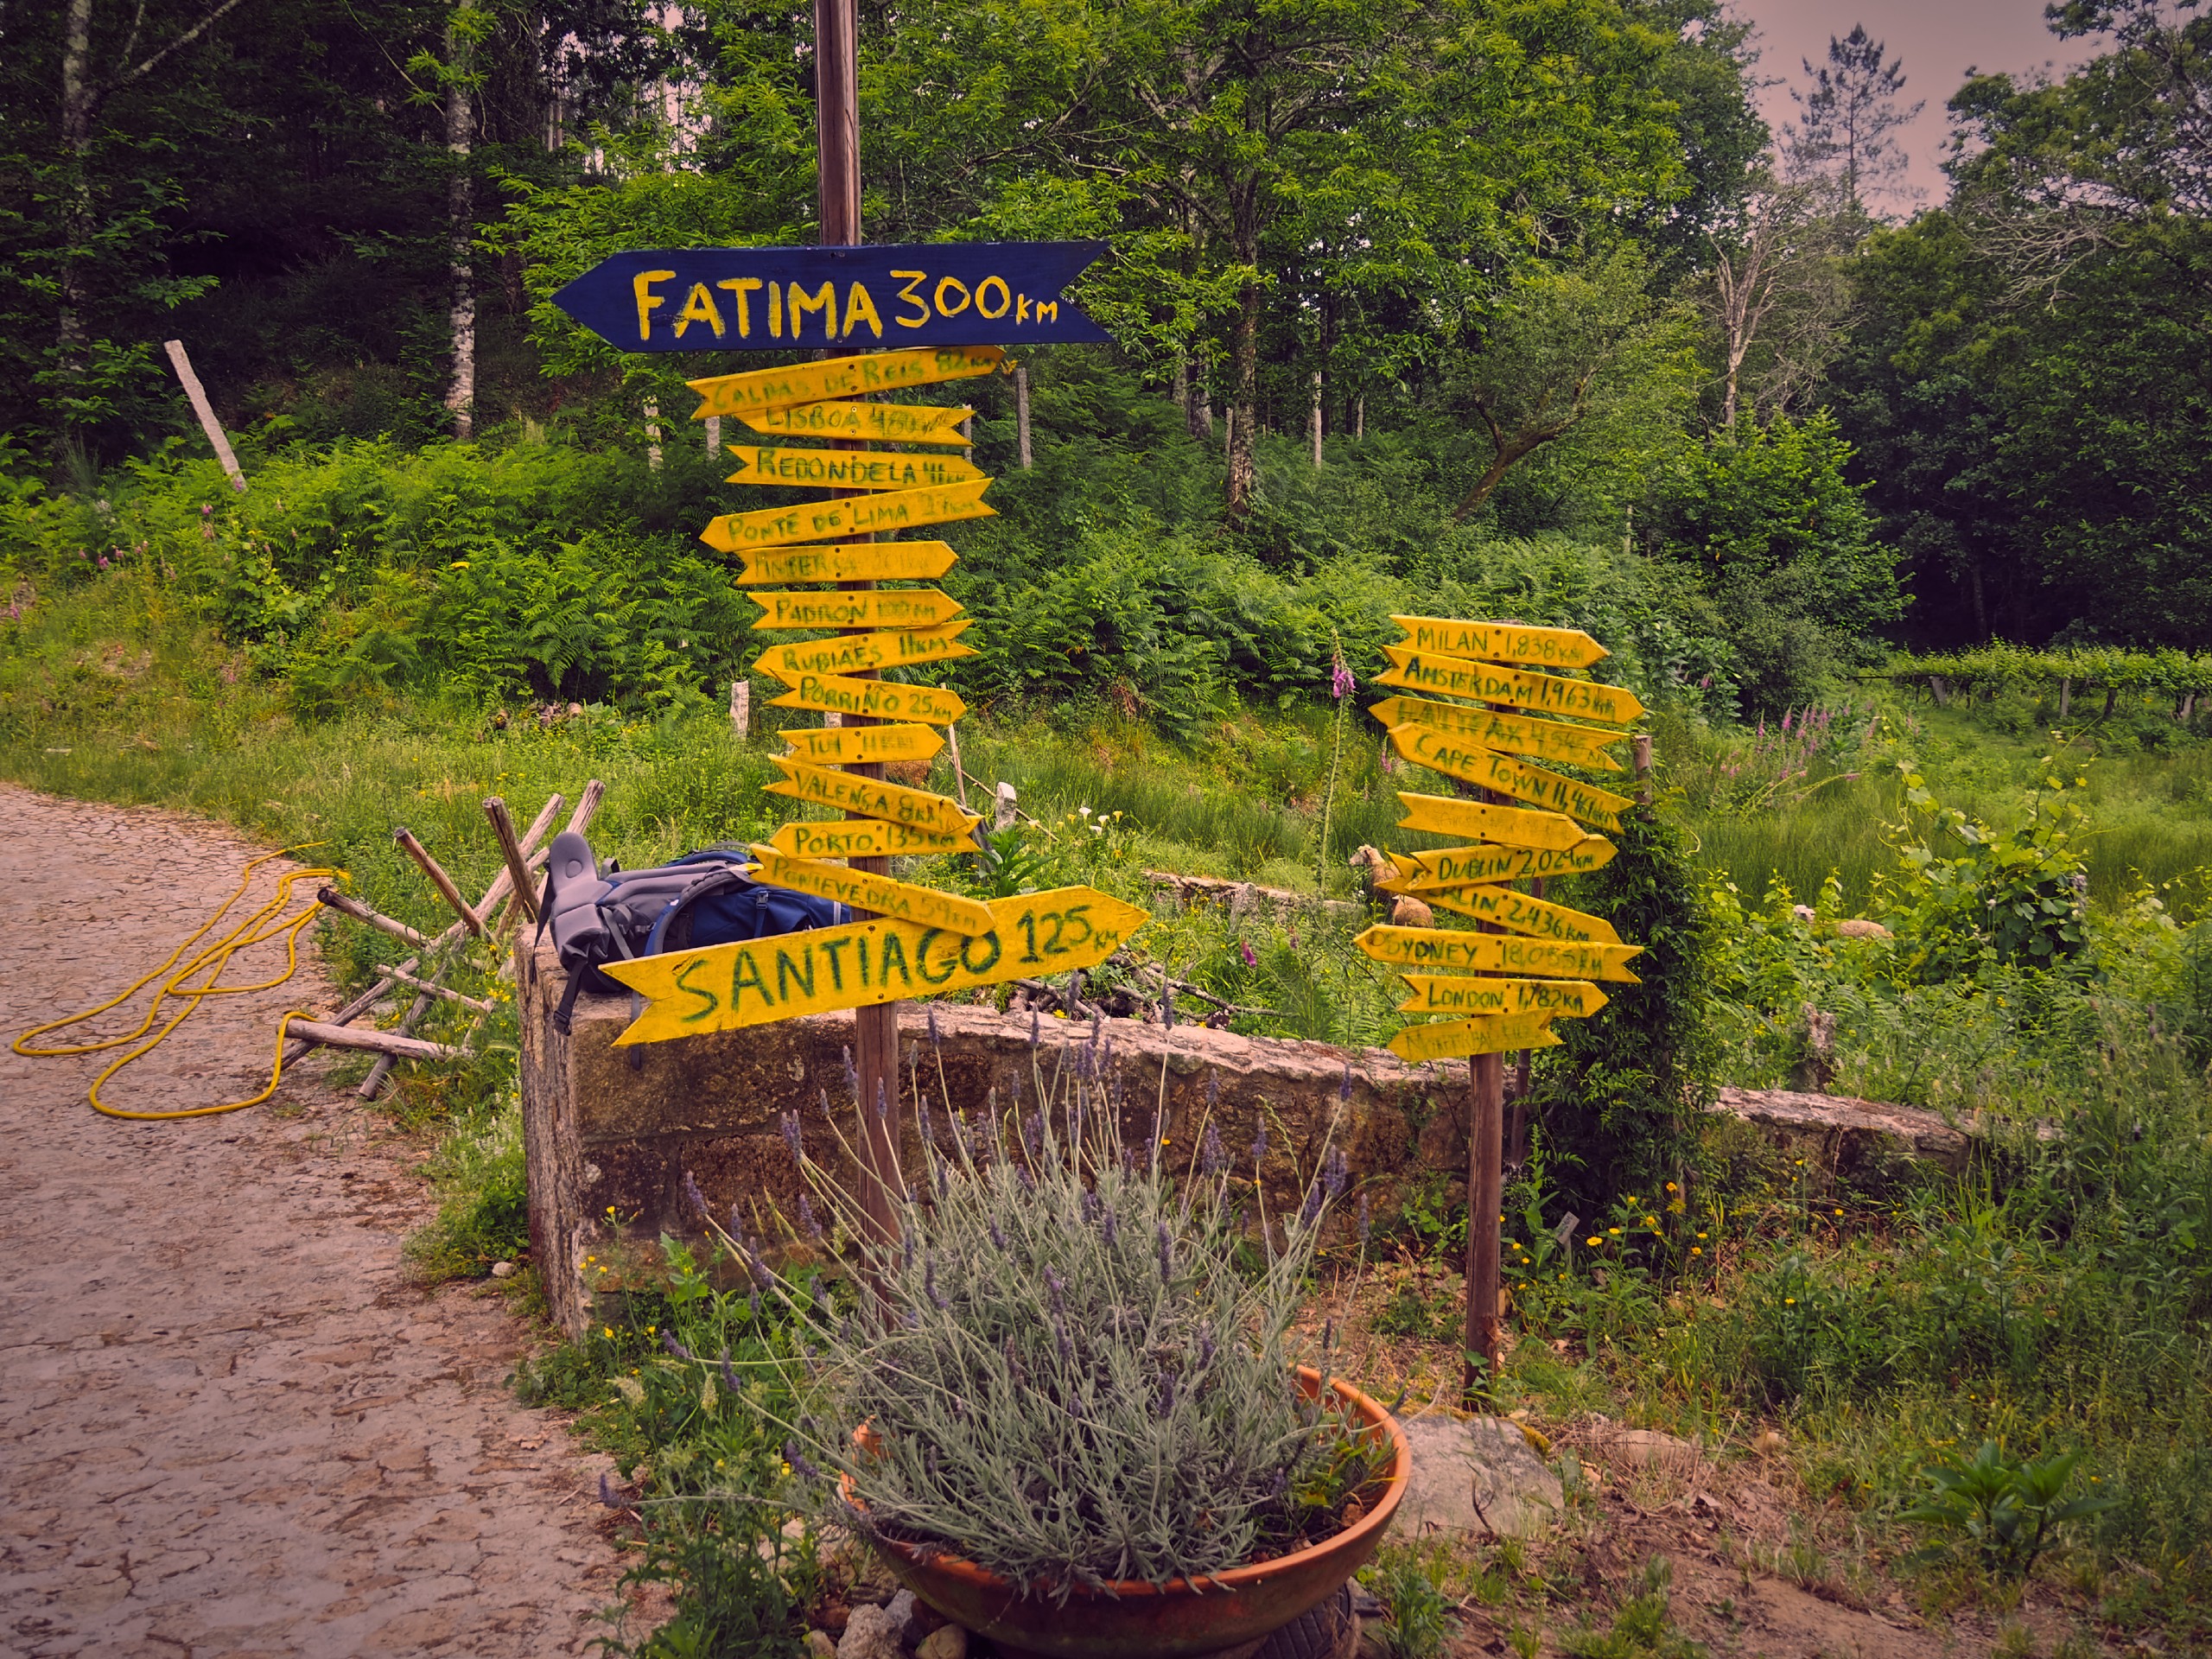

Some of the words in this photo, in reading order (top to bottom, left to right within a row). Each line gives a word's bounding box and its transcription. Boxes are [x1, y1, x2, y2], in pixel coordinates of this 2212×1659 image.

[632, 270, 883, 341] FATIMA
[767, 406, 861, 429] LISBOA
[757, 448, 917, 484] REDONDELA
[854, 504, 907, 525] LIMA
[1417, 627, 1488, 652] MILAN
[1403, 656, 1534, 702] AMSTERDAM
[1415, 734, 1476, 772] CAPE
[1486, 754, 1548, 798] TOWN
[795, 828, 874, 854] PORTO
[1439, 855, 1512, 880] DUBLIN
[675, 929, 1001, 1023] SANTIAGO
[1428, 982, 1504, 1008] LONDON
